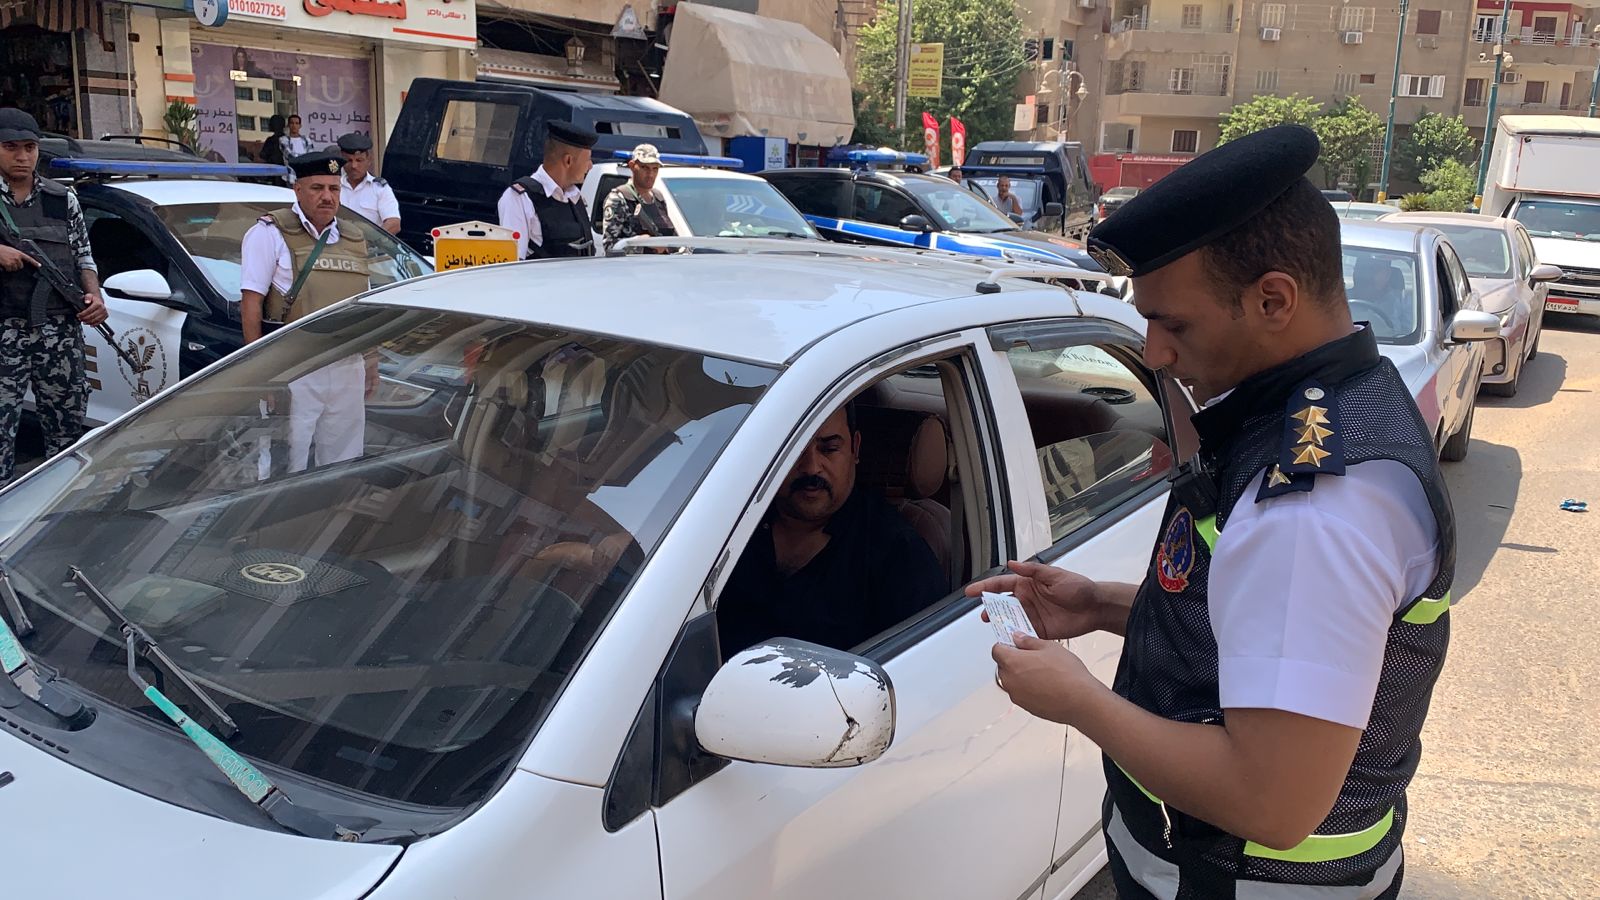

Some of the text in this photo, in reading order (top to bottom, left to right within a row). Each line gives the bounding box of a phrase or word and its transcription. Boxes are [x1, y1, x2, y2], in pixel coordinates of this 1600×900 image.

[229, 0, 286, 18] 01010277254
[308, 111, 342, 124] يدوم
[199, 120, 233, 134] 24 سا
[444, 254, 477, 269] المواطن
